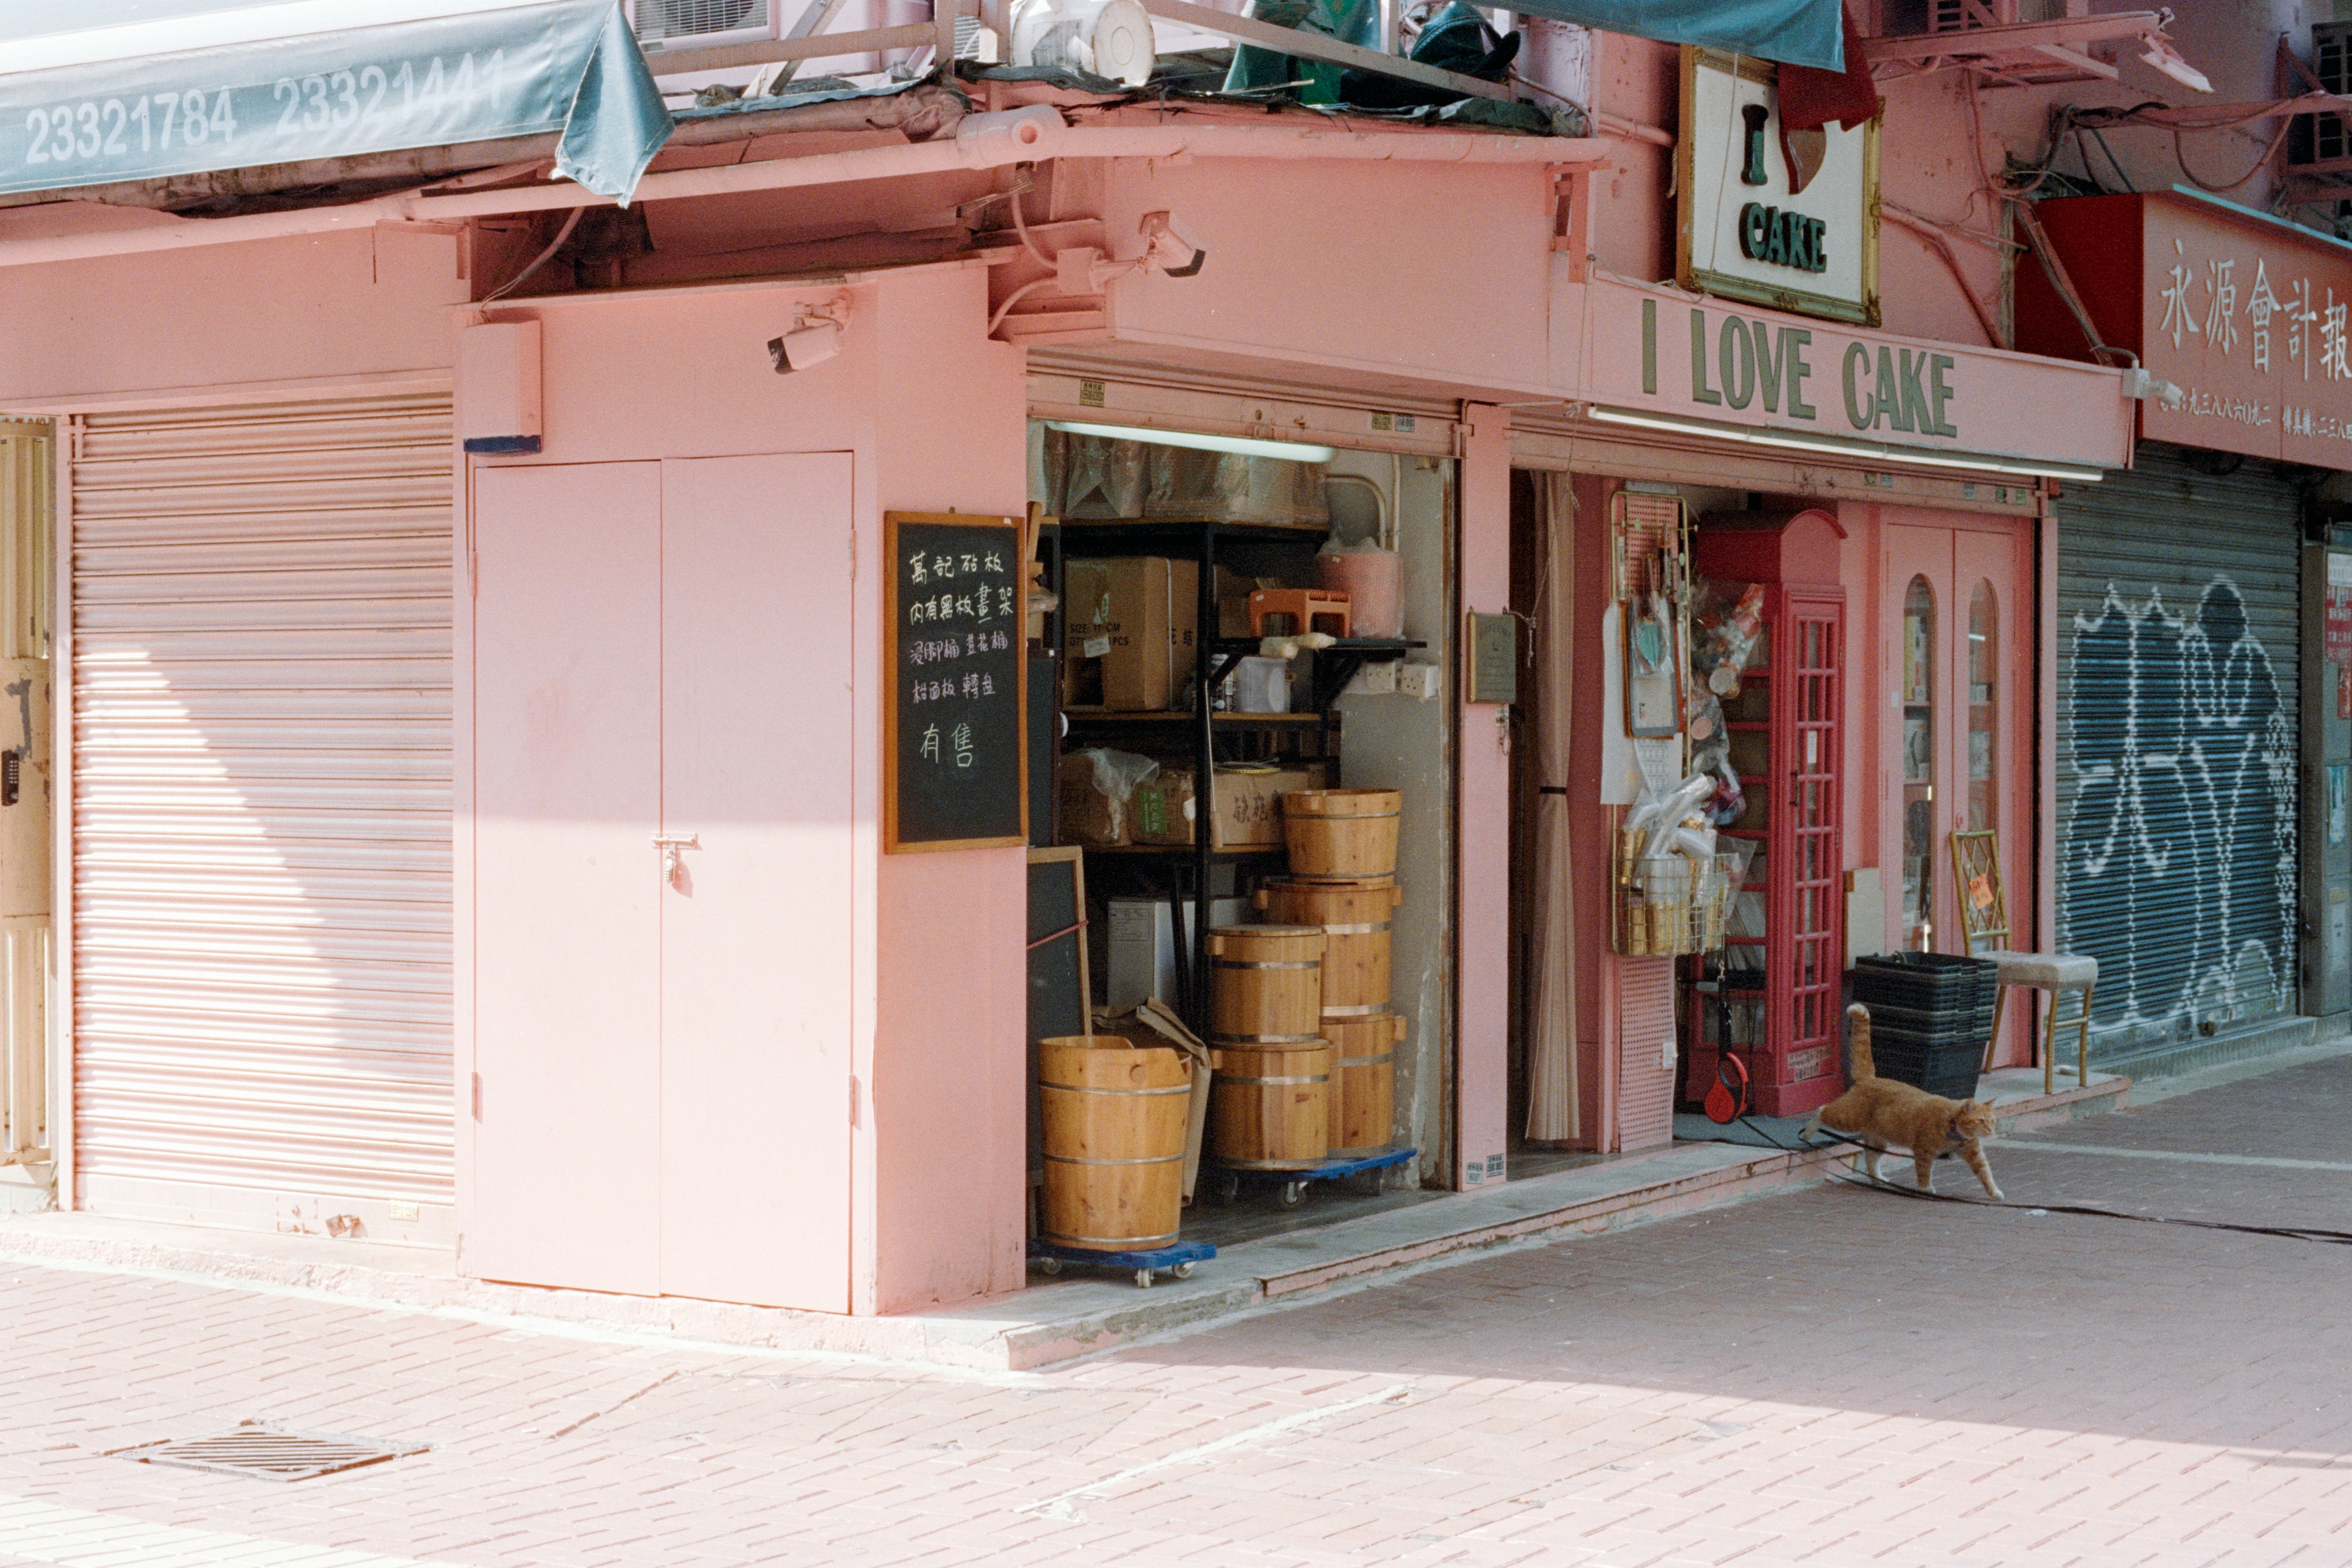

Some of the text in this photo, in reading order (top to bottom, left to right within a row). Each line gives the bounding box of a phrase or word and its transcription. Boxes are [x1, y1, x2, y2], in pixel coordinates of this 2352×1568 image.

[26, 48, 504, 163] 23321784 23321441
[1741, 104, 1769, 186] I
[1739, 202, 1827, 274] CAKE
[2160, 238, 2352, 382] 永源會計報
[1643, 299, 1957, 438] I LOVE CAKE
[919, 723, 973, 768] 有售
